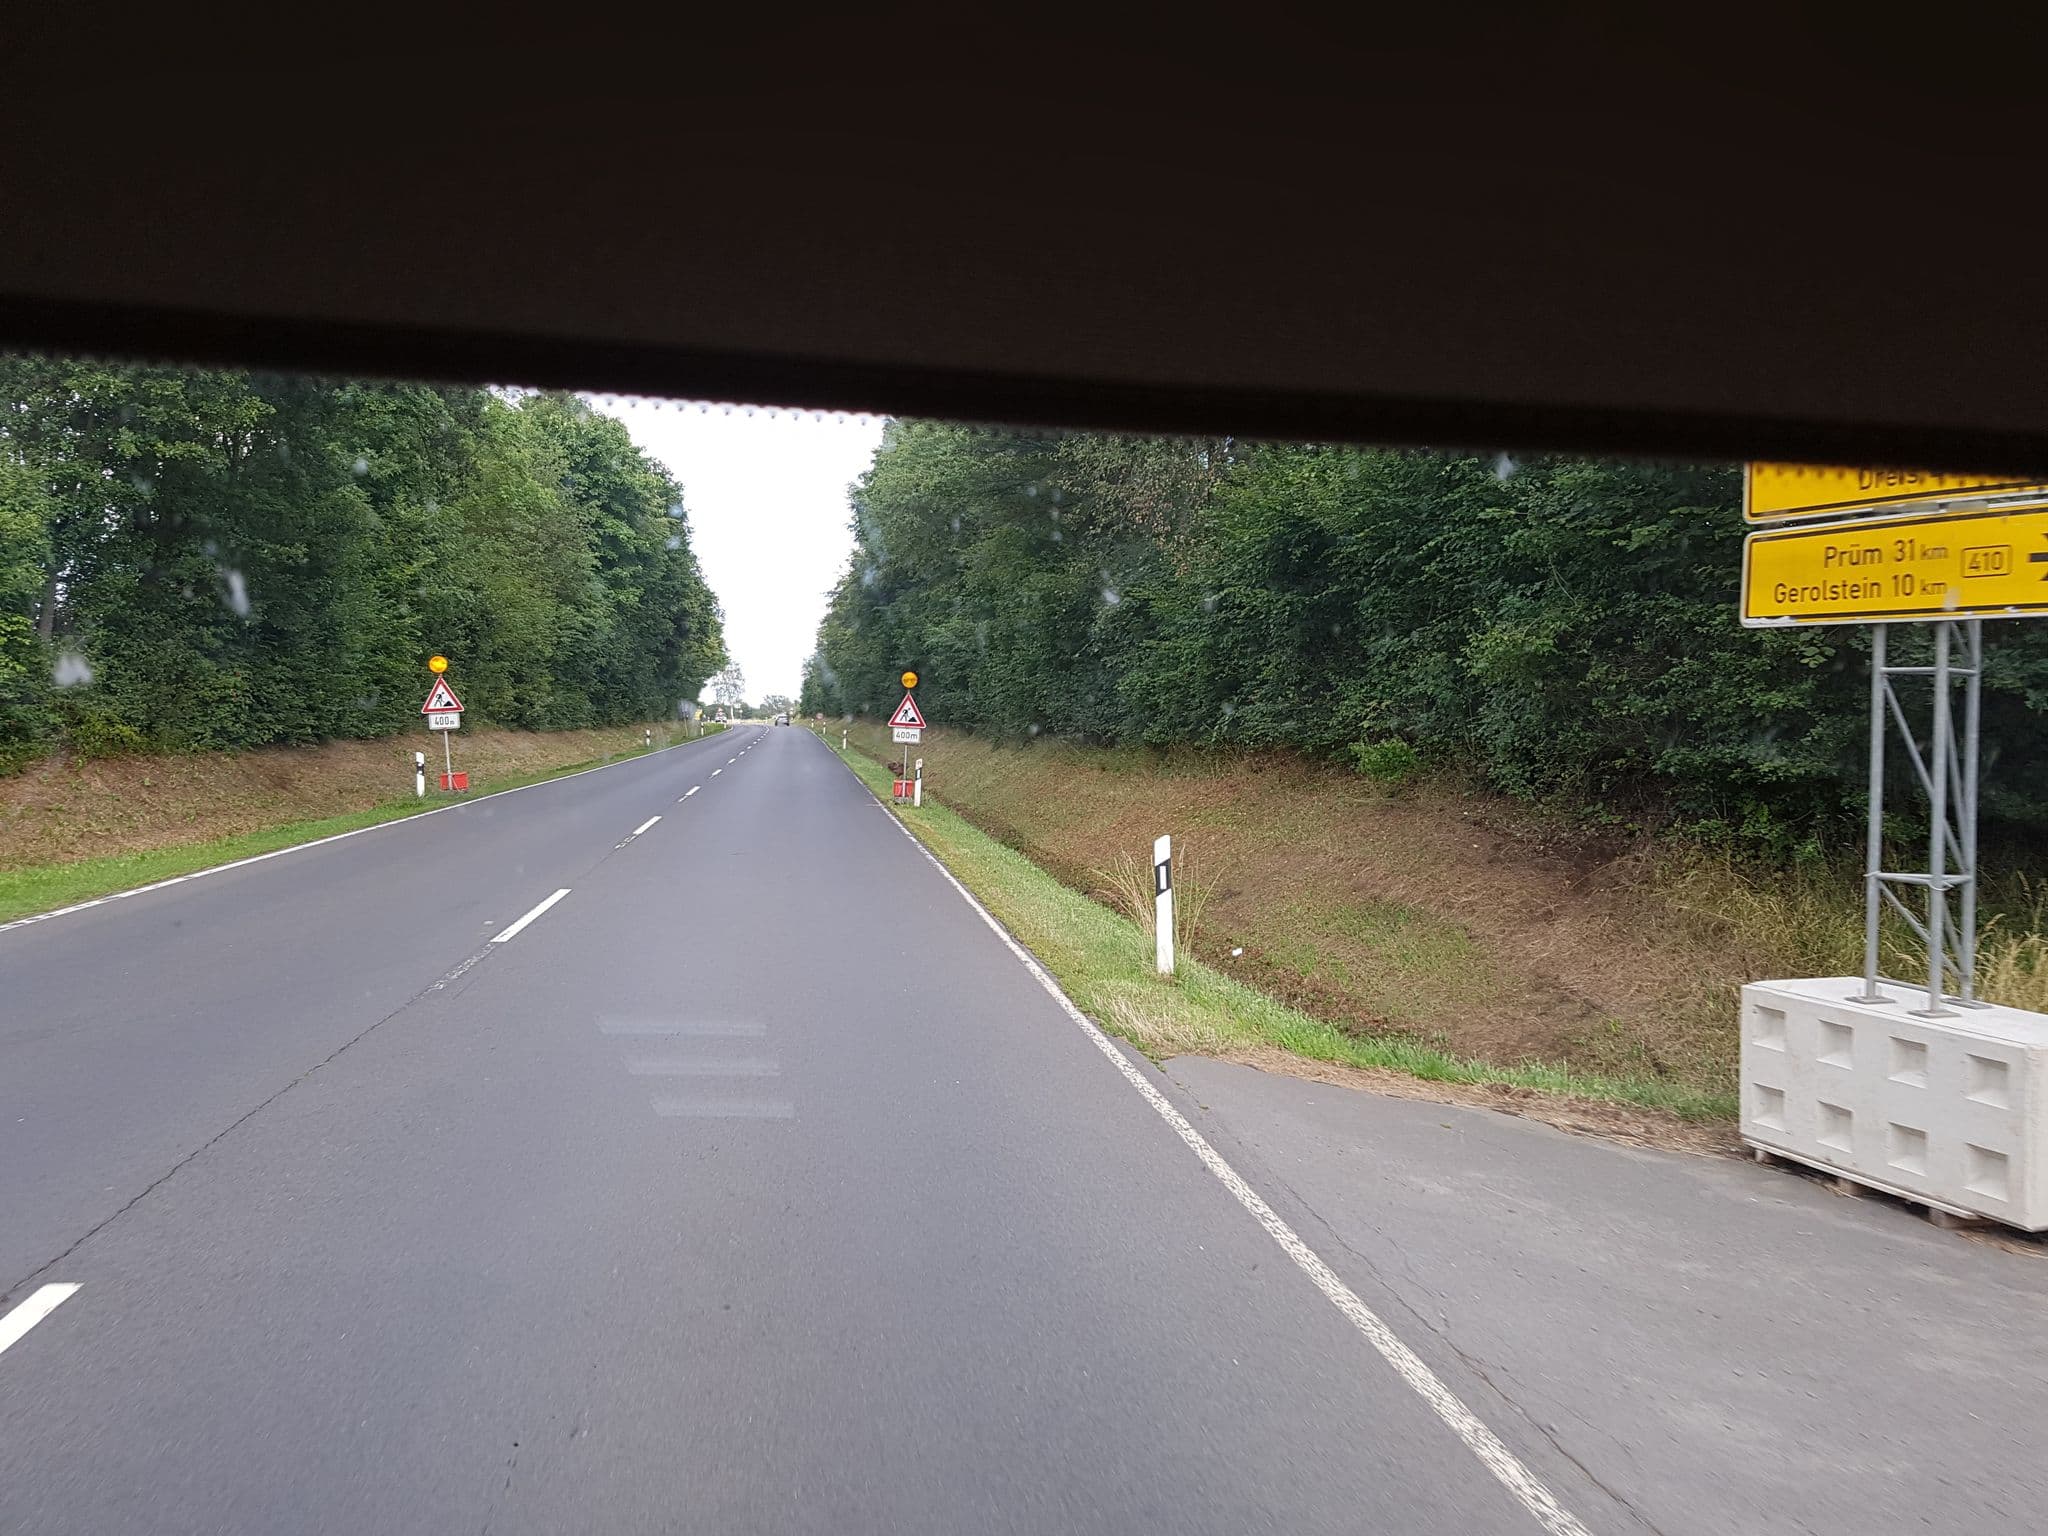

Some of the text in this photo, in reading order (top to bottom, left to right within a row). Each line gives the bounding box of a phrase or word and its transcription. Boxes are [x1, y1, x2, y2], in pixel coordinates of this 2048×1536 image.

[1824, 539, 1949, 568] Prüm 31 km
[1968, 552, 2004, 572] 410
[1774, 574, 1948, 604] Gerolstein 10 km
